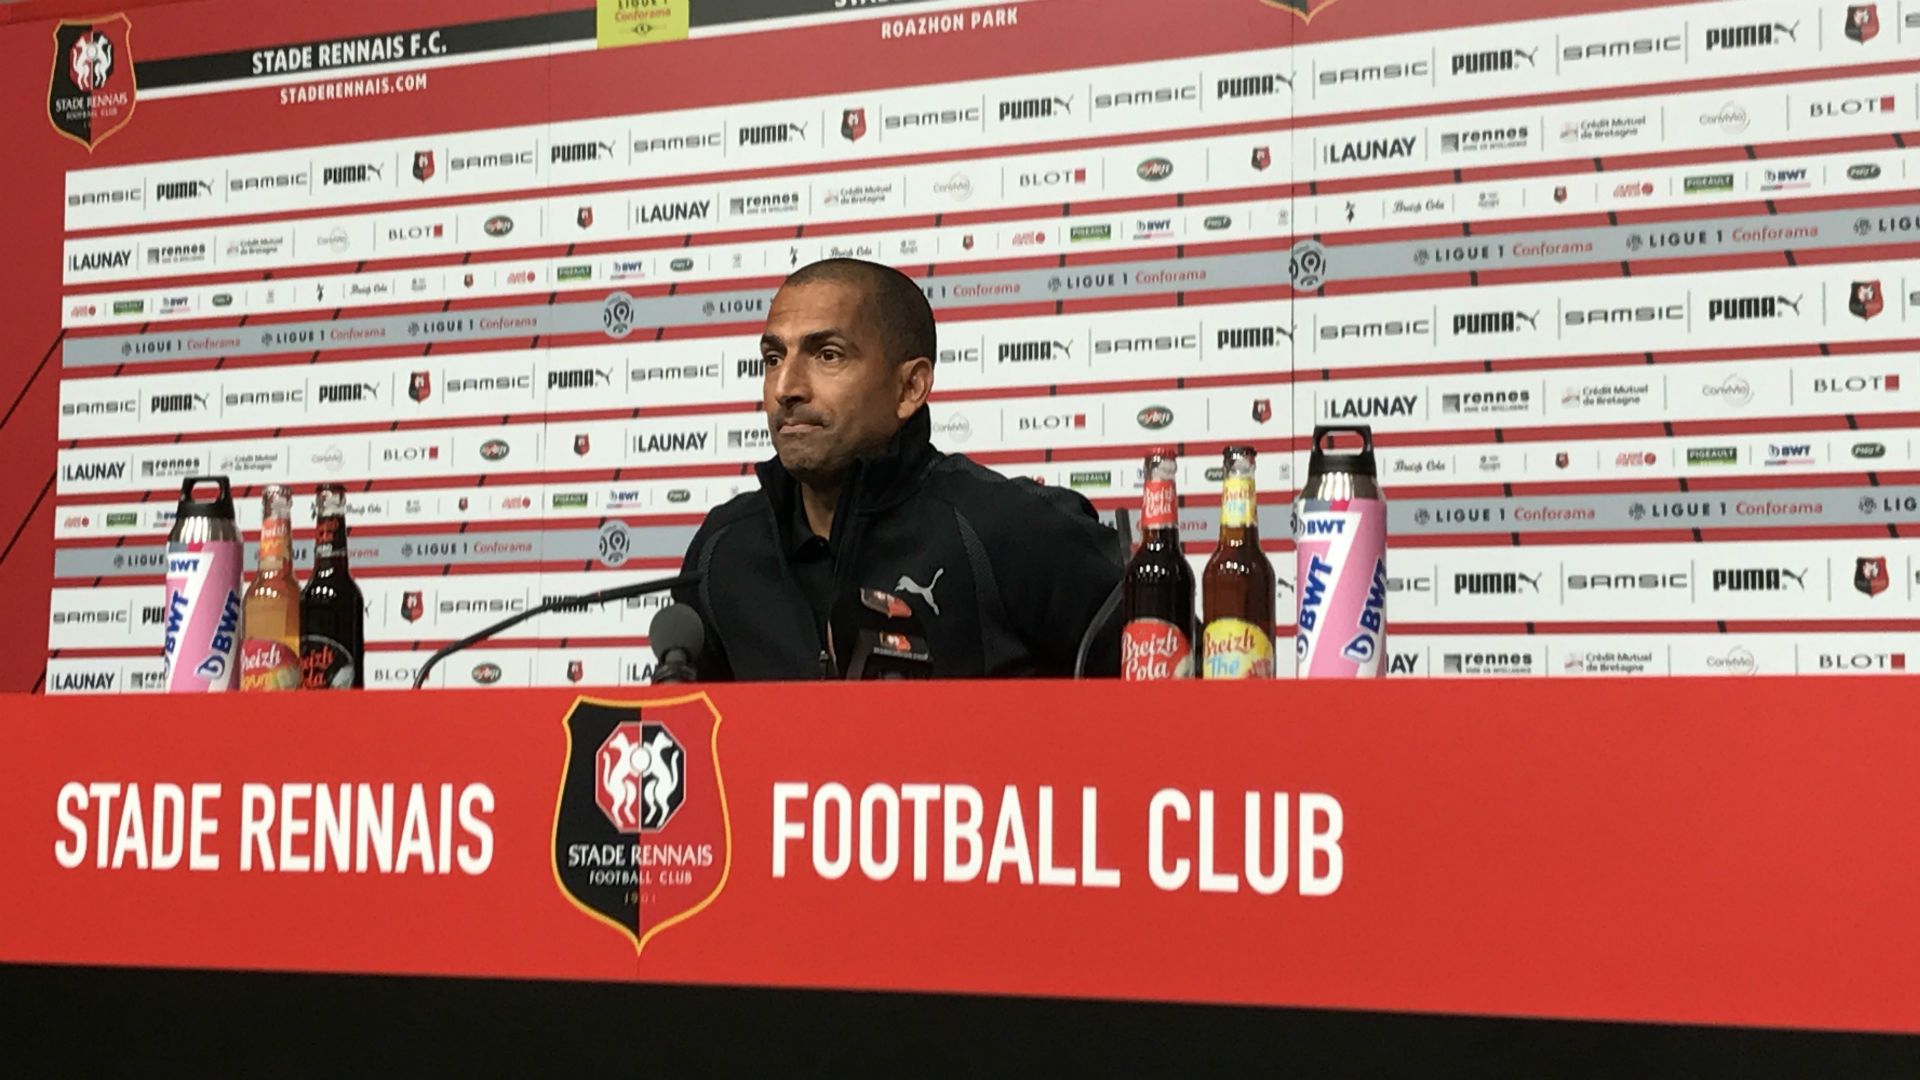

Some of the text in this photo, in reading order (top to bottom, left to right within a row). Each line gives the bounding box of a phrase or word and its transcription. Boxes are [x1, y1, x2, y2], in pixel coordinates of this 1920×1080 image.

[881, 7, 1018, 40] ROAZHON PARK
[1706, 23, 1772, 50] PUMA
[252, 31, 447, 75] STADE RENNAIS F.C.
[1563, 36, 1681, 61] SAMSIC
[1452, 49, 1513, 76] PUMA
[1319, 61, 1428, 85] SAMSIC
[280, 73, 427, 105] STADERENNAIS.COM
[1095, 86, 1197, 109] SAMSIC
[1217, 76, 1274, 99] PUMA
[885, 107, 979, 129] SAMSIC
[999, 98, 1052, 121] PUMA
[1810, 99, 1878, 117] BLOT
[634, 132, 721, 153] SAMSIC
[739, 123, 788, 146] PUMA
[1462, 127, 1528, 143] rennes
[551, 142, 597, 164] PUMA
[1330, 136, 1416, 163] LAUNAY
[450, 151, 533, 171] SAMSIC
[230, 172, 308, 191] SAMSIC
[323, 164, 366, 185] PUMA
[1020, 170, 1072, 187] BLOT
[1778, 168, 1807, 181] BWT
[68, 188, 142, 206] SAMSIC
[156, 181, 198, 201] PUMA
[746, 192, 799, 207] rennes
[641, 200, 710, 223] LAUNAY
[388, 226, 432, 241] BLOT
[1649, 224, 1819, 248] LIGUE 1 Conforama
[73, 250, 131, 271] LAUNAY
[1435, 240, 1593, 262] LIGUE 1 Conforama
[1066, 269, 1206, 290] LIGUE 1 Conforama
[953, 282, 1020, 298] Conforama
[719, 299, 762, 314] LIGUE
[1565, 305, 1683, 325] SAMSIC
[1709, 296, 1775, 321] PUMA
[423, 316, 538, 334] LIGUE 1 Conforama
[1320, 320, 1429, 339] SAMSIC
[1453, 312, 1514, 335] PUMA
[276, 325, 386, 345] LIGUE 1 Conforama
[1095, 335, 1196, 353] SAMSIC
[1218, 327, 1274, 350] PUMA
[940, 348, 979, 363] SIC
[999, 341, 1051, 363] PUMA
[548, 369, 594, 389] PUMA
[631, 364, 719, 382] SAMSIC
[319, 383, 361, 404] PUMA
[447, 375, 530, 392] SAMSIC
[1814, 376, 1882, 393] BLOT
[151, 394, 192, 414] PUMA
[225, 389, 303, 406] SAMSIC
[1331, 395, 1417, 419] LAUNAY
[1463, 390, 1529, 404] rennes
[62, 399, 136, 417] SAMSIC
[1019, 415, 1072, 430] BLOT
[638, 432, 709, 453] LAUNAY
[1781, 445, 1811, 456] BWT
[384, 447, 427, 461] BLOT
[66, 462, 126, 482] LAUNAY
[1436, 506, 1596, 523] LIGUE 1 Conforama
[1652, 499, 1823, 517] LIGUE 1 Conforama
[1884, 497, 1918, 512] LIG
[1307, 519, 1346, 534] BWT
[417, 541, 532, 556] LIGUE 1 Conforama
[170, 558, 199, 572] BWT
[1387, 578, 1430, 592] SIC
[1455, 573, 1516, 594] PUMA
[1568, 573, 1688, 590] SAMSIC
[1713, 569, 1780, 591] PUMA
[1300, 555, 1333, 632] BWT
[1361, 557, 1388, 633] BWT
[440, 599, 524, 614] SAMSIC
[53, 611, 127, 625] SAMSIC
[166, 590, 189, 653] BWT
[213, 590, 241, 653] BWT
[1122, 628, 1179, 664] Breizh
[1203, 627, 1256, 658] Breizh
[1125, 656, 1168, 682] Cola
[1465, 653, 1532, 666] rennes
[1819, 655, 1888, 669] BLOT
[55, 672, 115, 690] LAUNAY
[55, 781, 495, 875] STADE RENNAIS
[772, 782, 1344, 896] FOOTBALL CLUB
[568, 844, 713, 867] STADE RENNAIS
[589, 870, 692, 885] FOOTBALL CLUB
